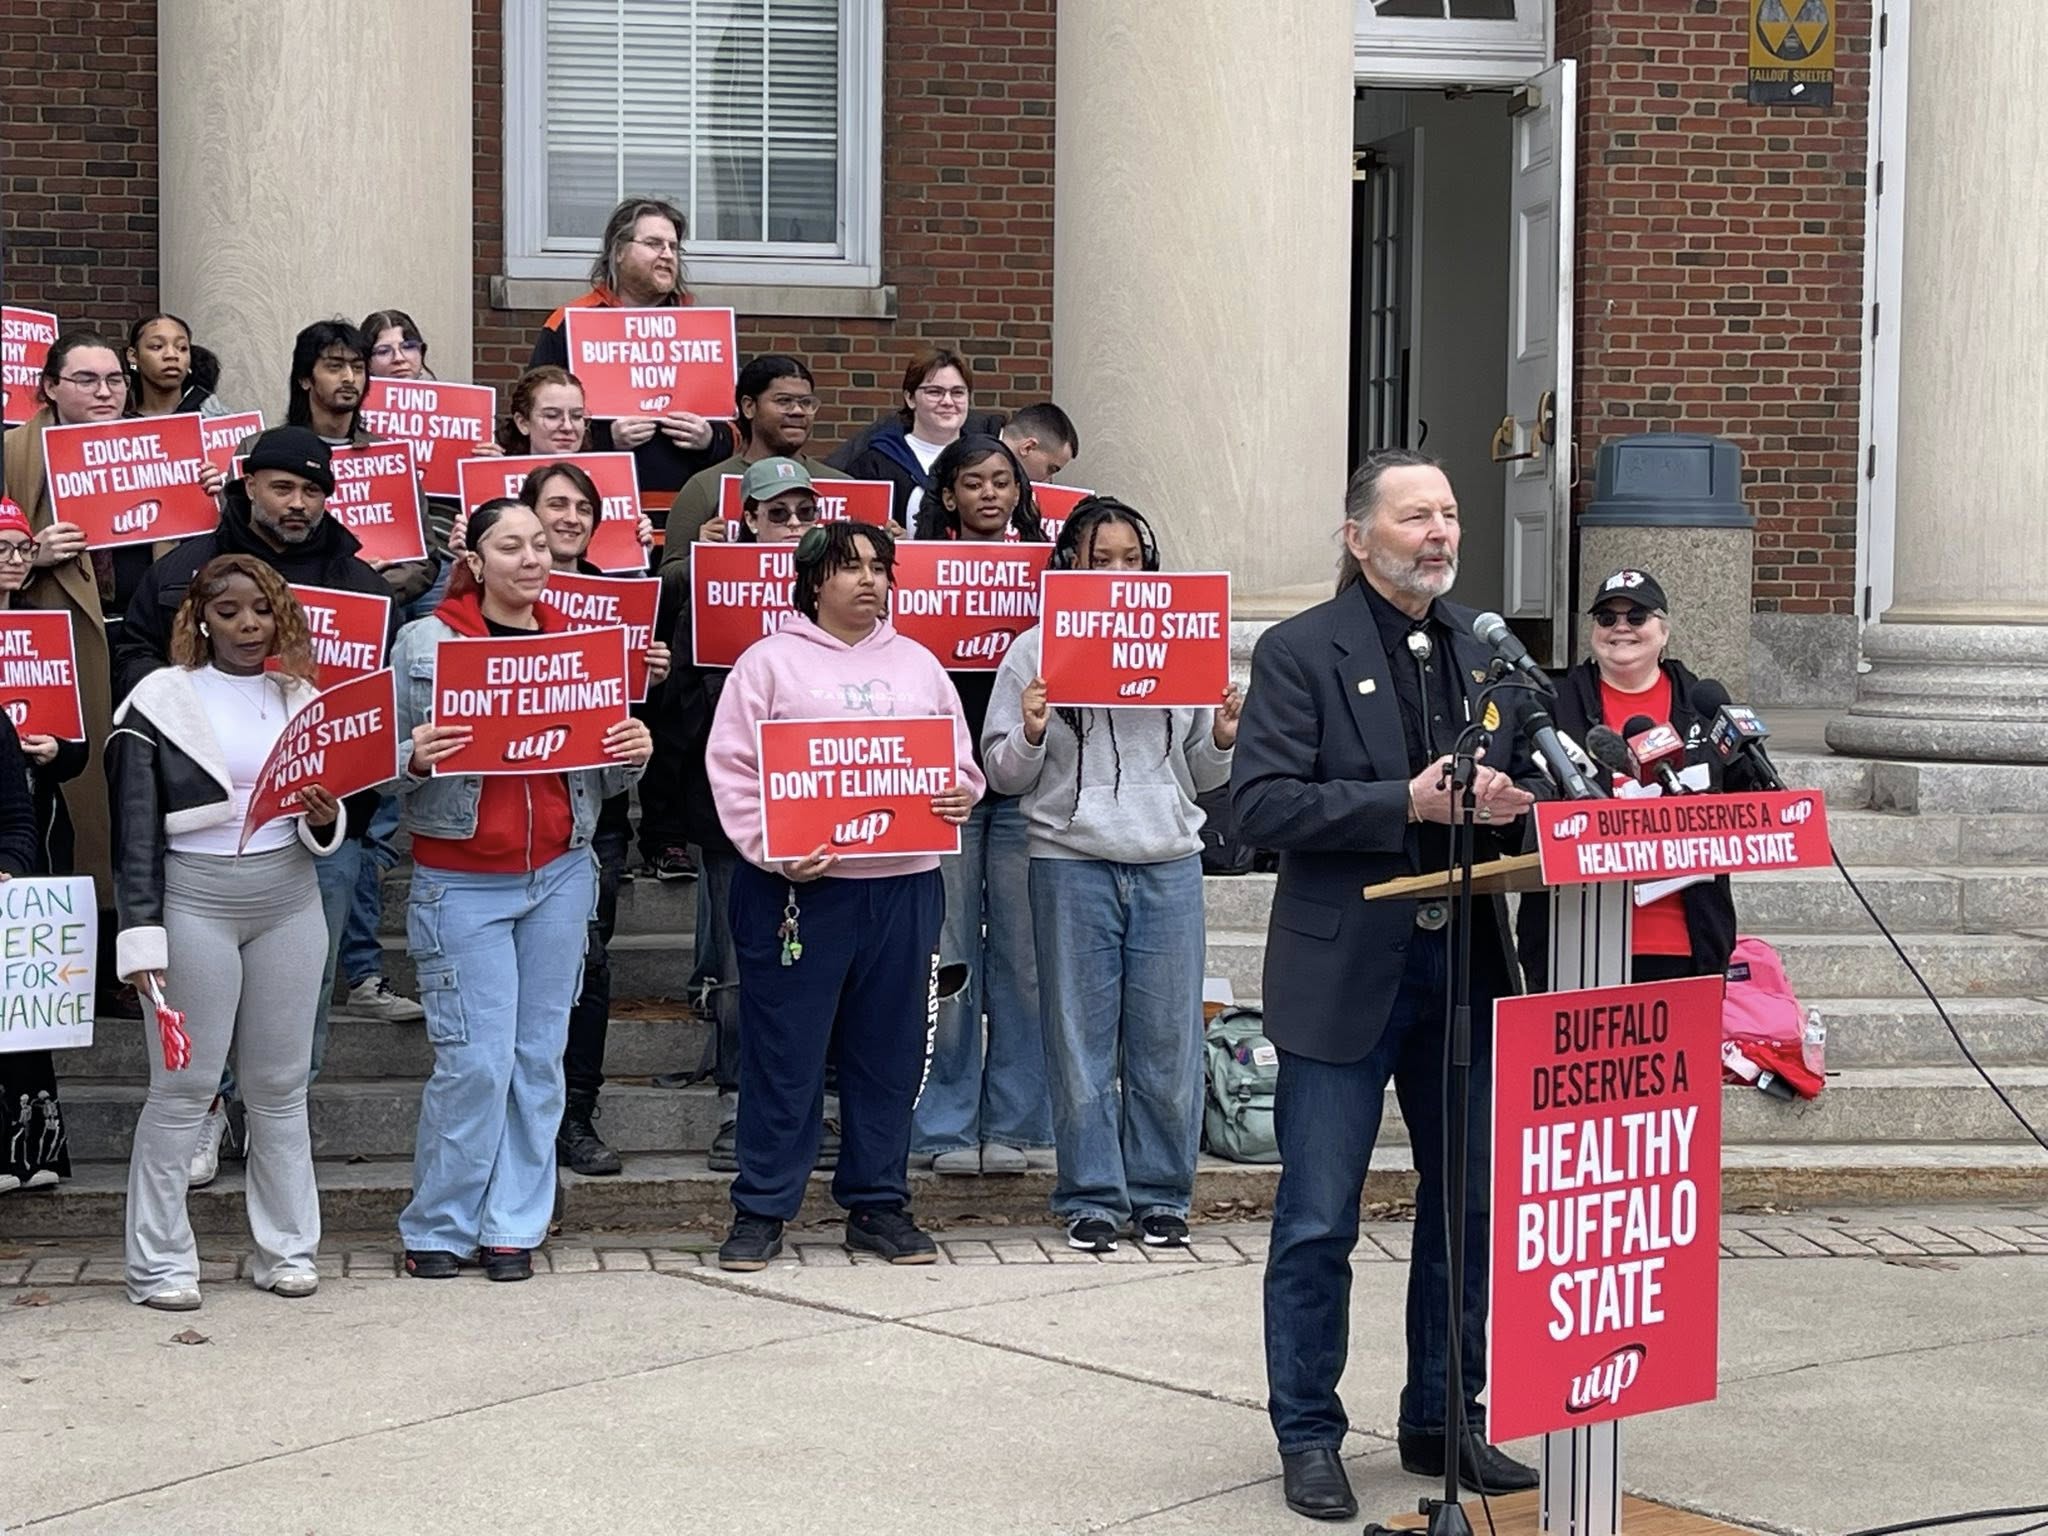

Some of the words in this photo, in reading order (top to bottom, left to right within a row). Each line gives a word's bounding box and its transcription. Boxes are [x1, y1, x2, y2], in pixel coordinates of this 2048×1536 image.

[1750, 69, 1789, 82] FALLOUT
[1793, 70, 1833, 83] SHELTER
[2, 319, 54, 344] SERVES
[625, 316, 677, 338] FUND
[581, 341, 665, 364] BUFFALO
[669, 340, 724, 363] STATE
[630, 366, 677, 389] NOW
[385, 387, 437, 412] FUND
[428, 415, 482, 441] STATE
[83, 434, 169, 467] EDUCATE,
[330, 453, 407, 480] ESERVES
[56, 471, 107, 498] DON'T
[113, 457, 202, 492] ELIMINATE
[113, 502, 158, 533] uup
[346, 502, 395, 527] STATE
[936, 559, 1036, 590] EDUCATE,
[898, 589, 961, 616] DON'T
[966, 591, 1040, 617] ELIMIN
[1110, 581, 1172, 609] FUND
[1055, 610, 1156, 639] BUFFALO
[1161, 612, 1221, 639] STATE
[955, 631, 1010, 660] uup
[1112, 642, 1168, 669] NOW
[486, 651, 590, 685] EDUCATE,
[442, 688, 513, 717] DON'T
[517, 677, 624, 715] ELIMINATE
[279, 701, 325, 750] FUND
[316, 707, 383, 747] STATE
[507, 728, 567, 761] uup
[808, 736, 913, 768] EDUCATE,
[274, 750, 325, 792] NOW
[770, 770, 836, 801] DON'T
[840, 767, 950, 797] ELIMINATE
[834, 812, 890, 845] uup
[1553, 814, 1588, 838] uup
[1599, 806, 1670, 837] BUFFALO
[1676, 802, 1757, 834] DESERVES
[1761, 802, 1772, 829] A
[1779, 799, 1812, 823] uup
[1577, 840, 1658, 875] HEALTHY
[1663, 835, 1743, 871] BUFFALO
[1746, 832, 1799, 864] STATE
[0, 885, 73, 919] CAN
[5, 923, 86, 959] ERE
[6, 961, 58, 990] FOR
[1554, 1000, 1669, 1056] BUFFALO
[1533, 1053, 1665, 1112] DESERVES
[1672, 1050, 1689, 1094] A
[1521, 1105, 1699, 1197] HEALTHY
[1517, 1178, 1698, 1273] BUFFALO
[1547, 1256, 1666, 1343] STATE
[1570, 1347, 1640, 1406] uup
